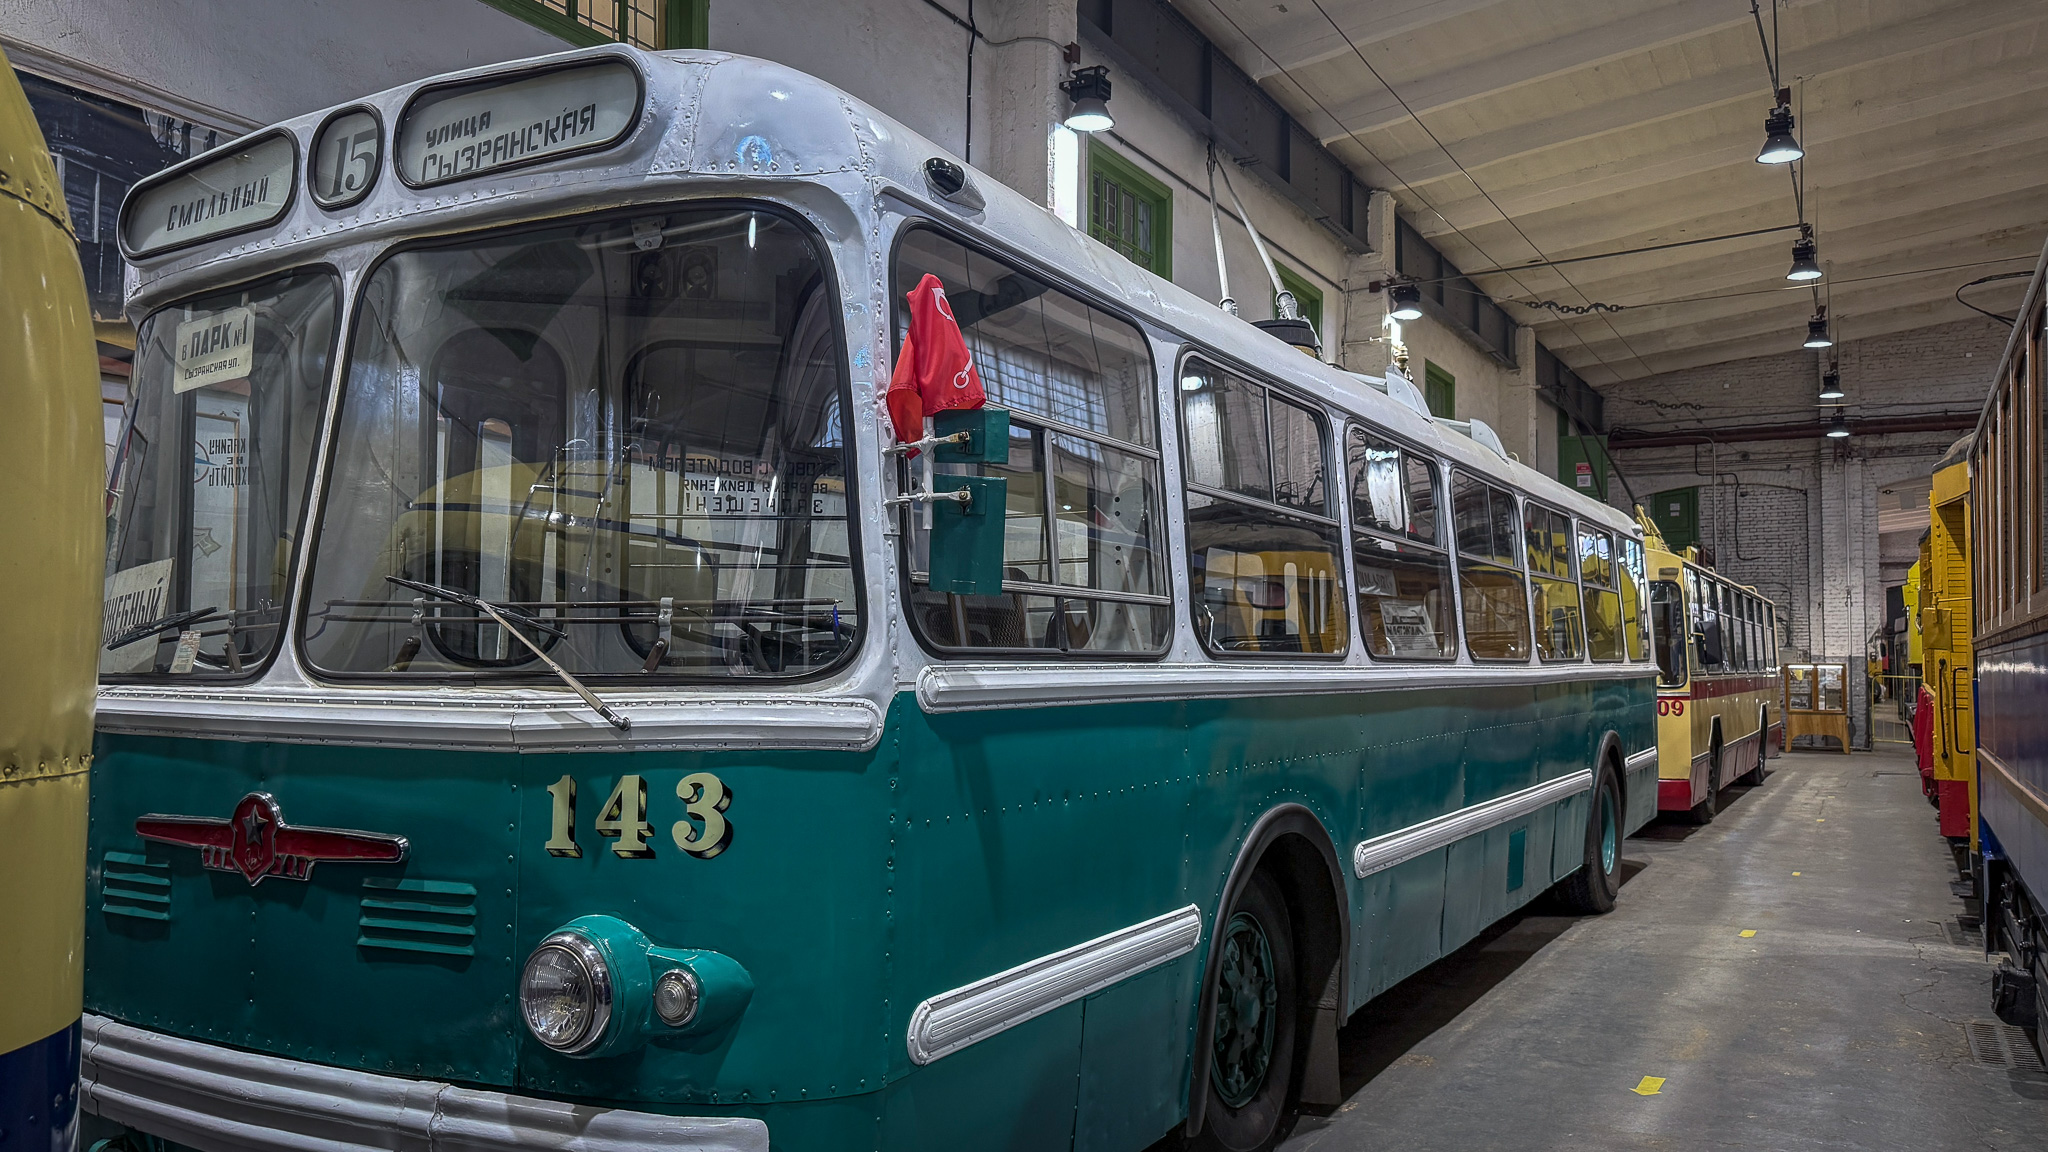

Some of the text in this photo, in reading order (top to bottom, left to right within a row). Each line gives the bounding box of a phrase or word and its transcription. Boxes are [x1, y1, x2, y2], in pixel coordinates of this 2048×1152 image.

[426, 110, 492, 149] УЛИЦА
[327, 128, 377, 199] 15
[166, 174, 270, 232] СМОЛЬНЫЙ
[181, 344, 188, 361] В
[190, 321, 233, 359] ПАРК
[544, 772, 734, 860] 143
